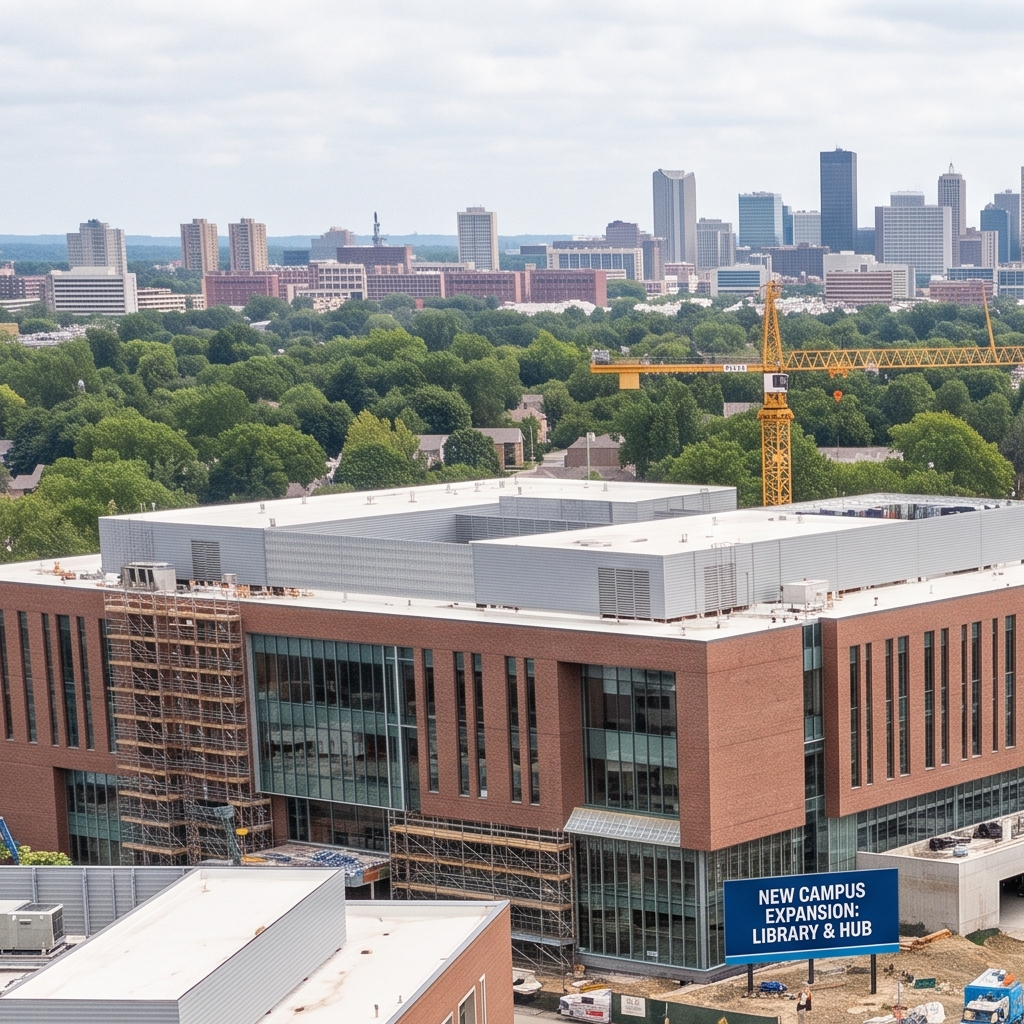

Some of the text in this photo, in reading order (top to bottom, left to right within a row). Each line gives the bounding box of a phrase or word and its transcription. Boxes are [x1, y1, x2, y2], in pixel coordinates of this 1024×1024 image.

[758, 882, 866, 906] NEW CAMPUS
[765, 902, 859, 924] EXPANSION:
[752, 920, 873, 945] LIBRARY & HUB
